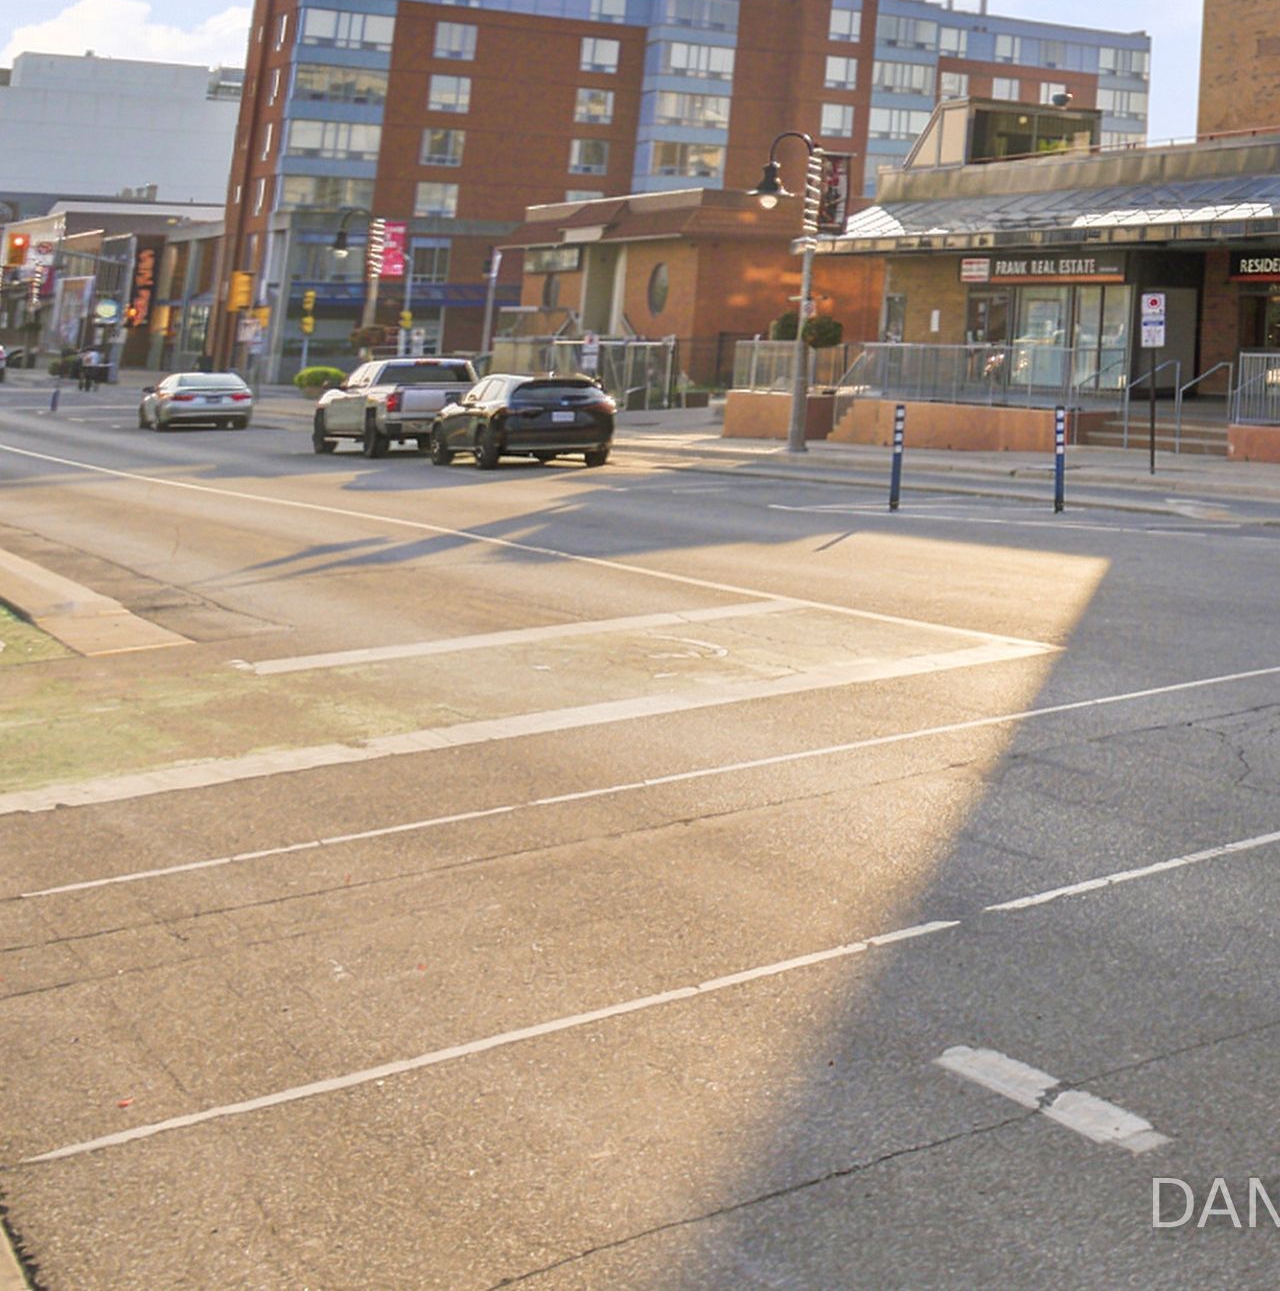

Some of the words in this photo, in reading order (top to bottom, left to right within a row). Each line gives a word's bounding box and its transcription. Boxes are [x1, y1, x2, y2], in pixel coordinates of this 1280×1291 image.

[995, 261, 1027, 275] FRANK
[1031, 260, 1055, 275] REAL
[1058, 259, 1096, 274] ESTATE
